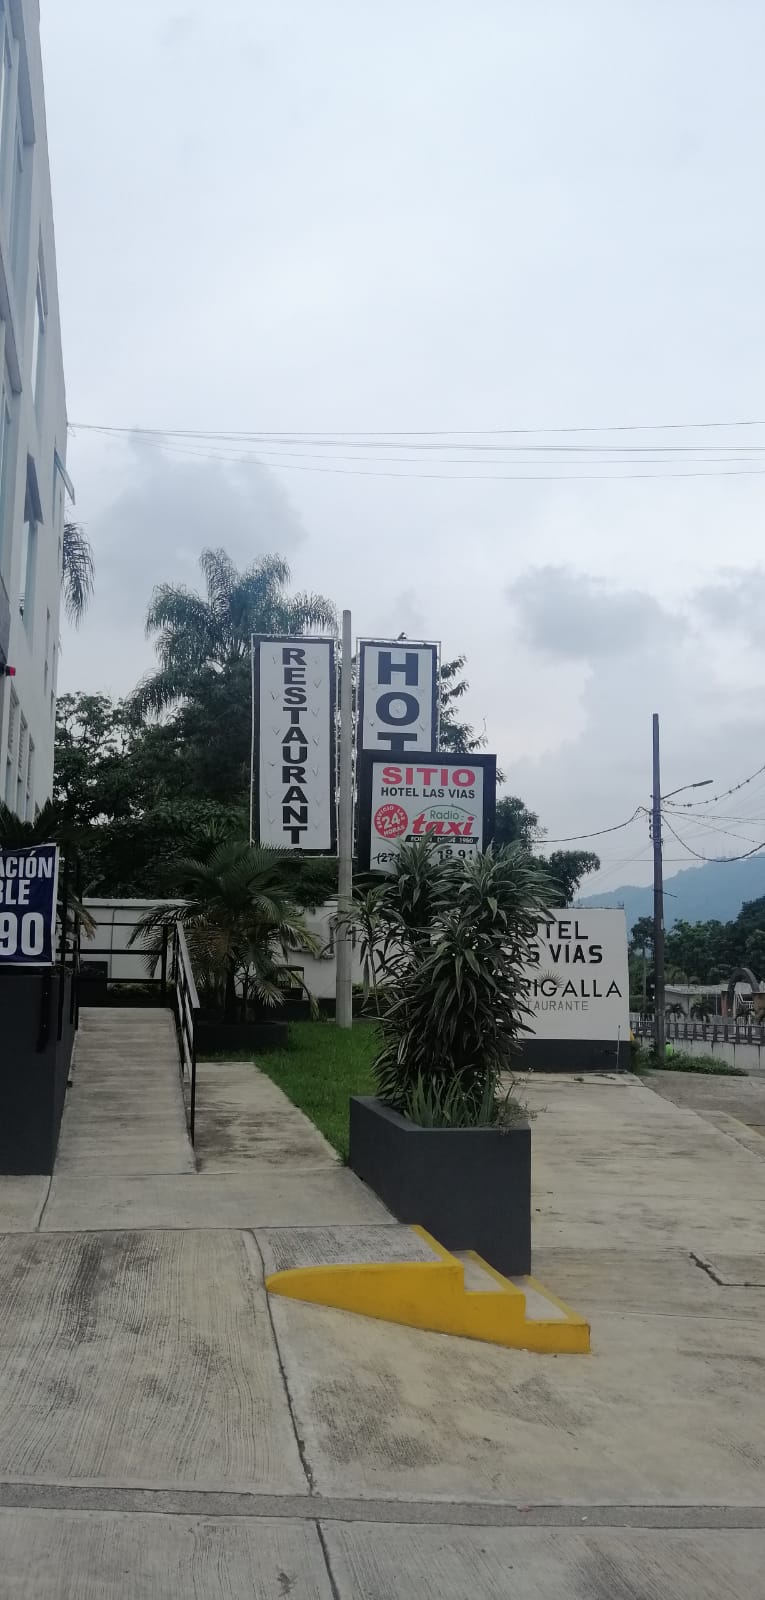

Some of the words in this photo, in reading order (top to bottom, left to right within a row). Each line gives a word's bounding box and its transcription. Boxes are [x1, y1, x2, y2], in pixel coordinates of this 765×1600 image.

[281, 647, 309, 845] RESTAURANT
[381, 766, 476, 787] SITIO
[380, 787, 419, 797] HOTEL
[422, 788, 445, 798] LAS
[381, 812, 401, 830] 24
[412, 813, 475, 836] taxi
[548, 940, 603, 964] VÍAS
